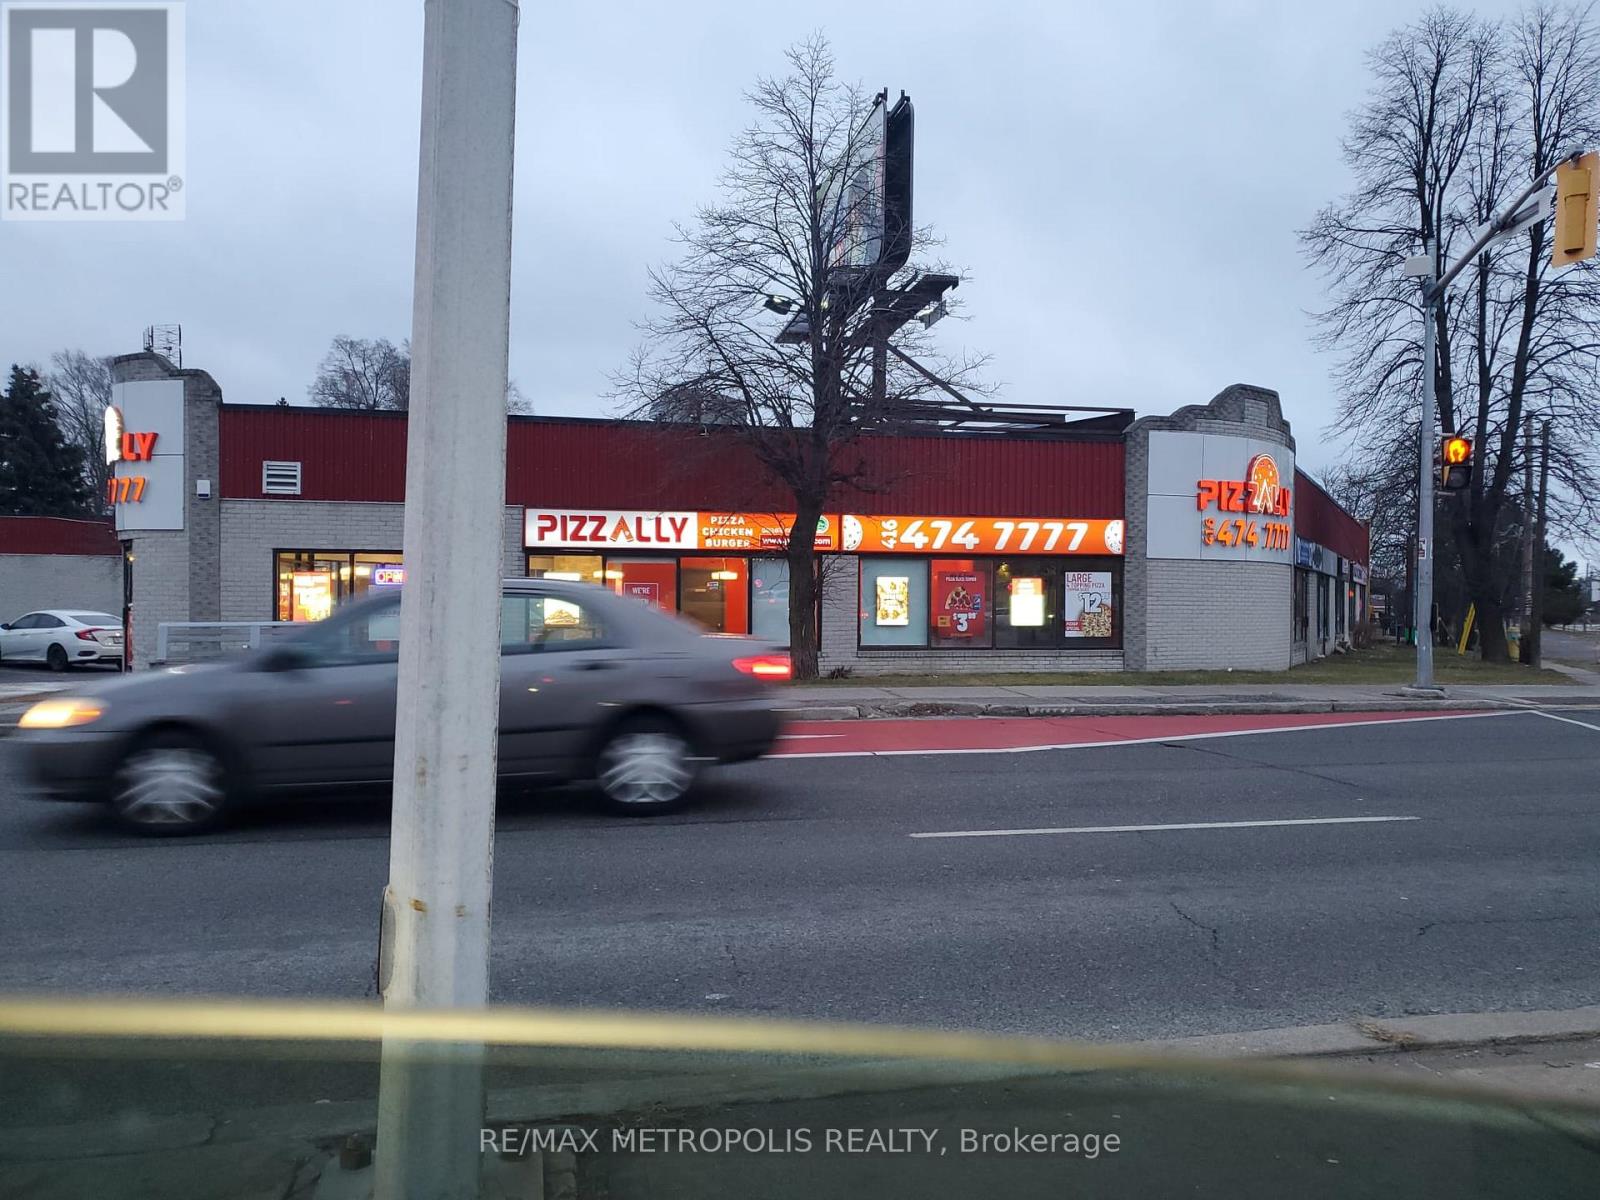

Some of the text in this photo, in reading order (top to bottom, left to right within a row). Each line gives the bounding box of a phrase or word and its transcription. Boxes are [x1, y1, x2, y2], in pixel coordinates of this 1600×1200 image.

[122, 432, 159, 461] LY
[710, 516, 745, 525] PIZZA
[537, 514, 689, 543] PIZZALLY
[702, 527, 753, 536] CHICKEN
[1216, 519, 1259, 548] 474
[880, 519, 1089, 551] 416 474 7777
[705, 538, 750, 547] BURGER
[1066, 573, 1093, 583] LARGE
[632, 587, 650, 595] WE'RE
